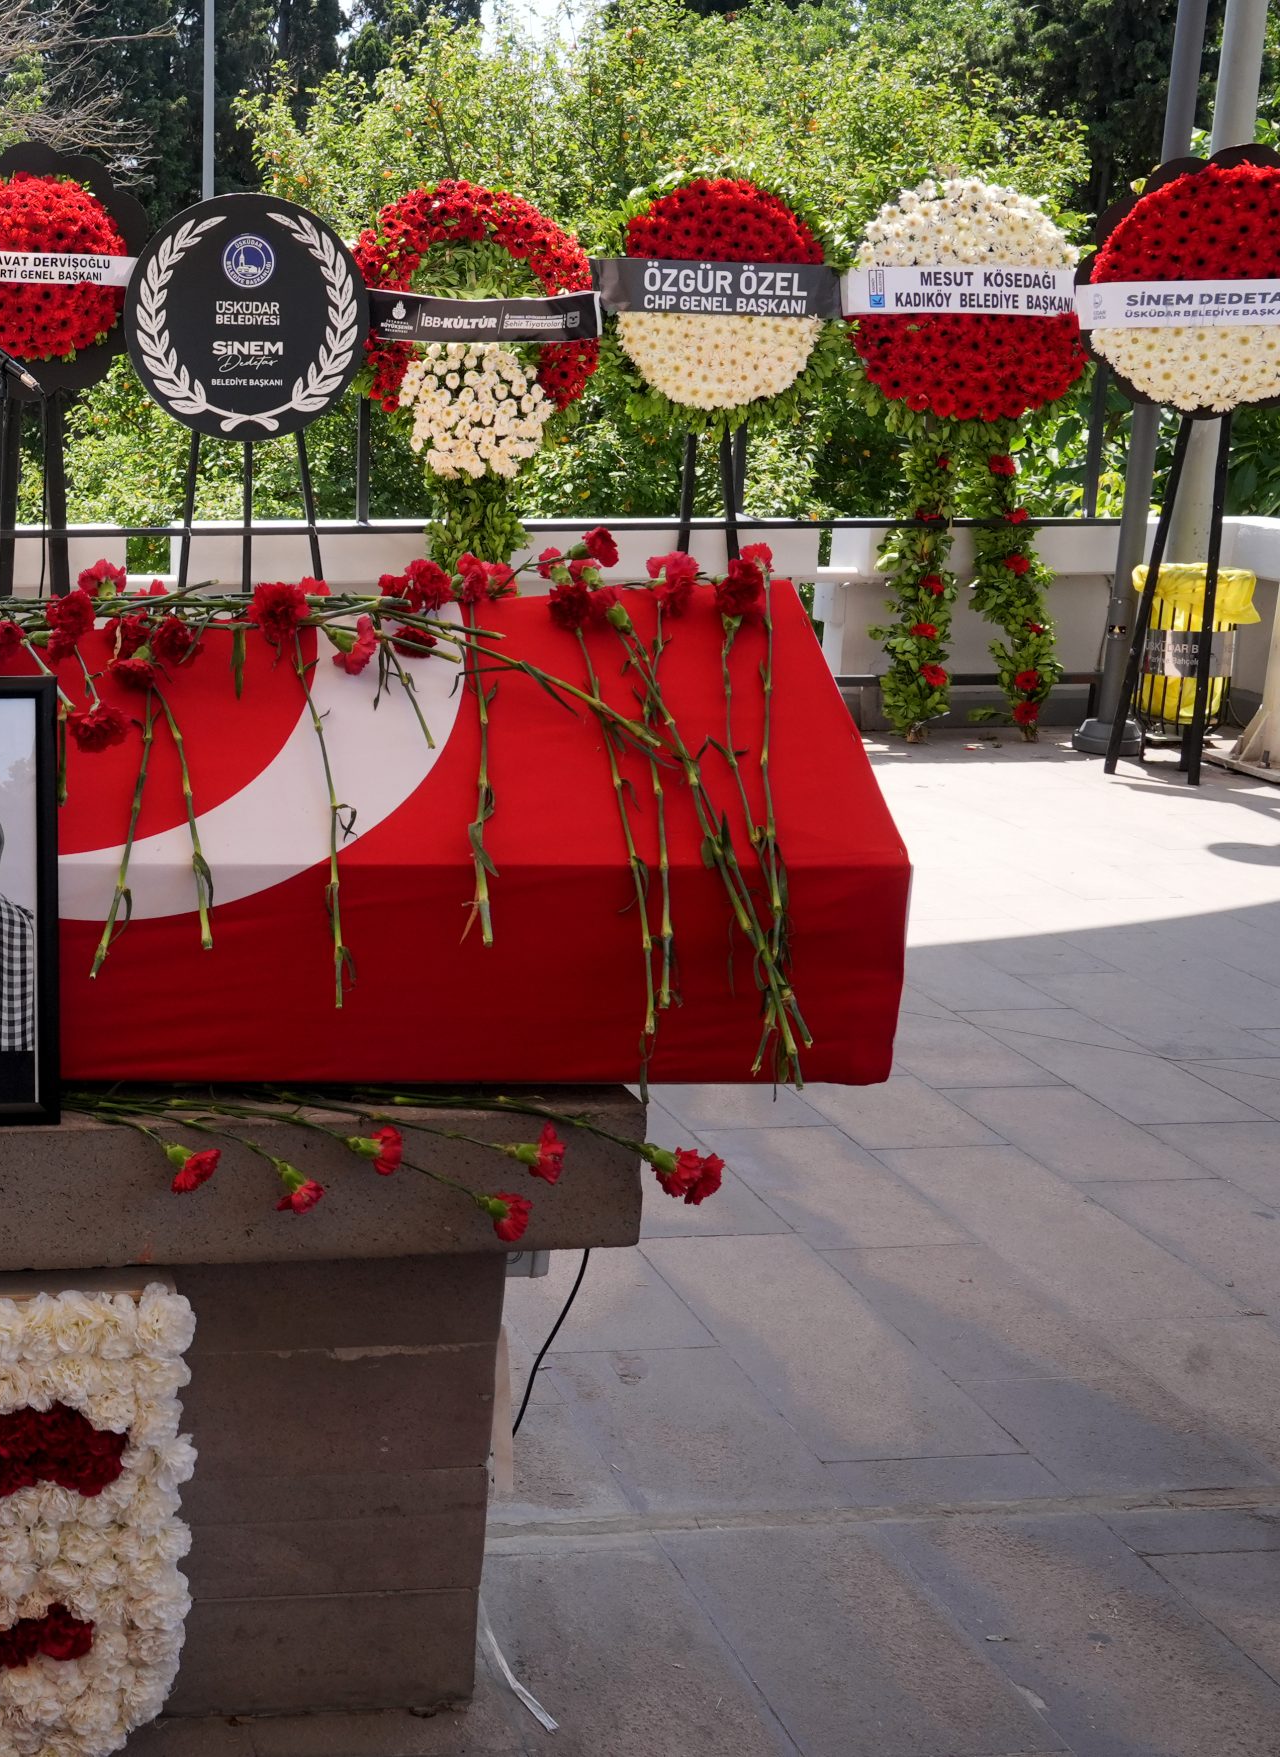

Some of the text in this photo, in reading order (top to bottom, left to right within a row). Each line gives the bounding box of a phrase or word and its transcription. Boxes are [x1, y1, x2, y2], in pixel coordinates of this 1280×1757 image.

[33, 255, 111, 270] DERVİŞOĞLU
[20, 269, 55, 280] GENEL
[58, 271, 102, 283] BAŞKANI
[643, 261, 808, 297] ÖZGÜR ÖZEL
[920, 269, 1056, 290] MESUT KÖSEDAĞI
[643, 294, 806, 316] CHP GENEL BAŞKANI
[894, 289, 1073, 314] KADIKÖY BELEDİYE BAŞKANI
[1125, 291, 1194, 307] SİNEM
[215, 300, 280, 315] ÜSKÜDAR
[1124, 308, 1181, 319] ÜSKÜDAR
[1183, 307, 1240, 318] BELEDİYE
[215, 314, 280, 326] BELEDİYESİ
[211, 377, 283, 388] BELEDİYE BAŞKANI
